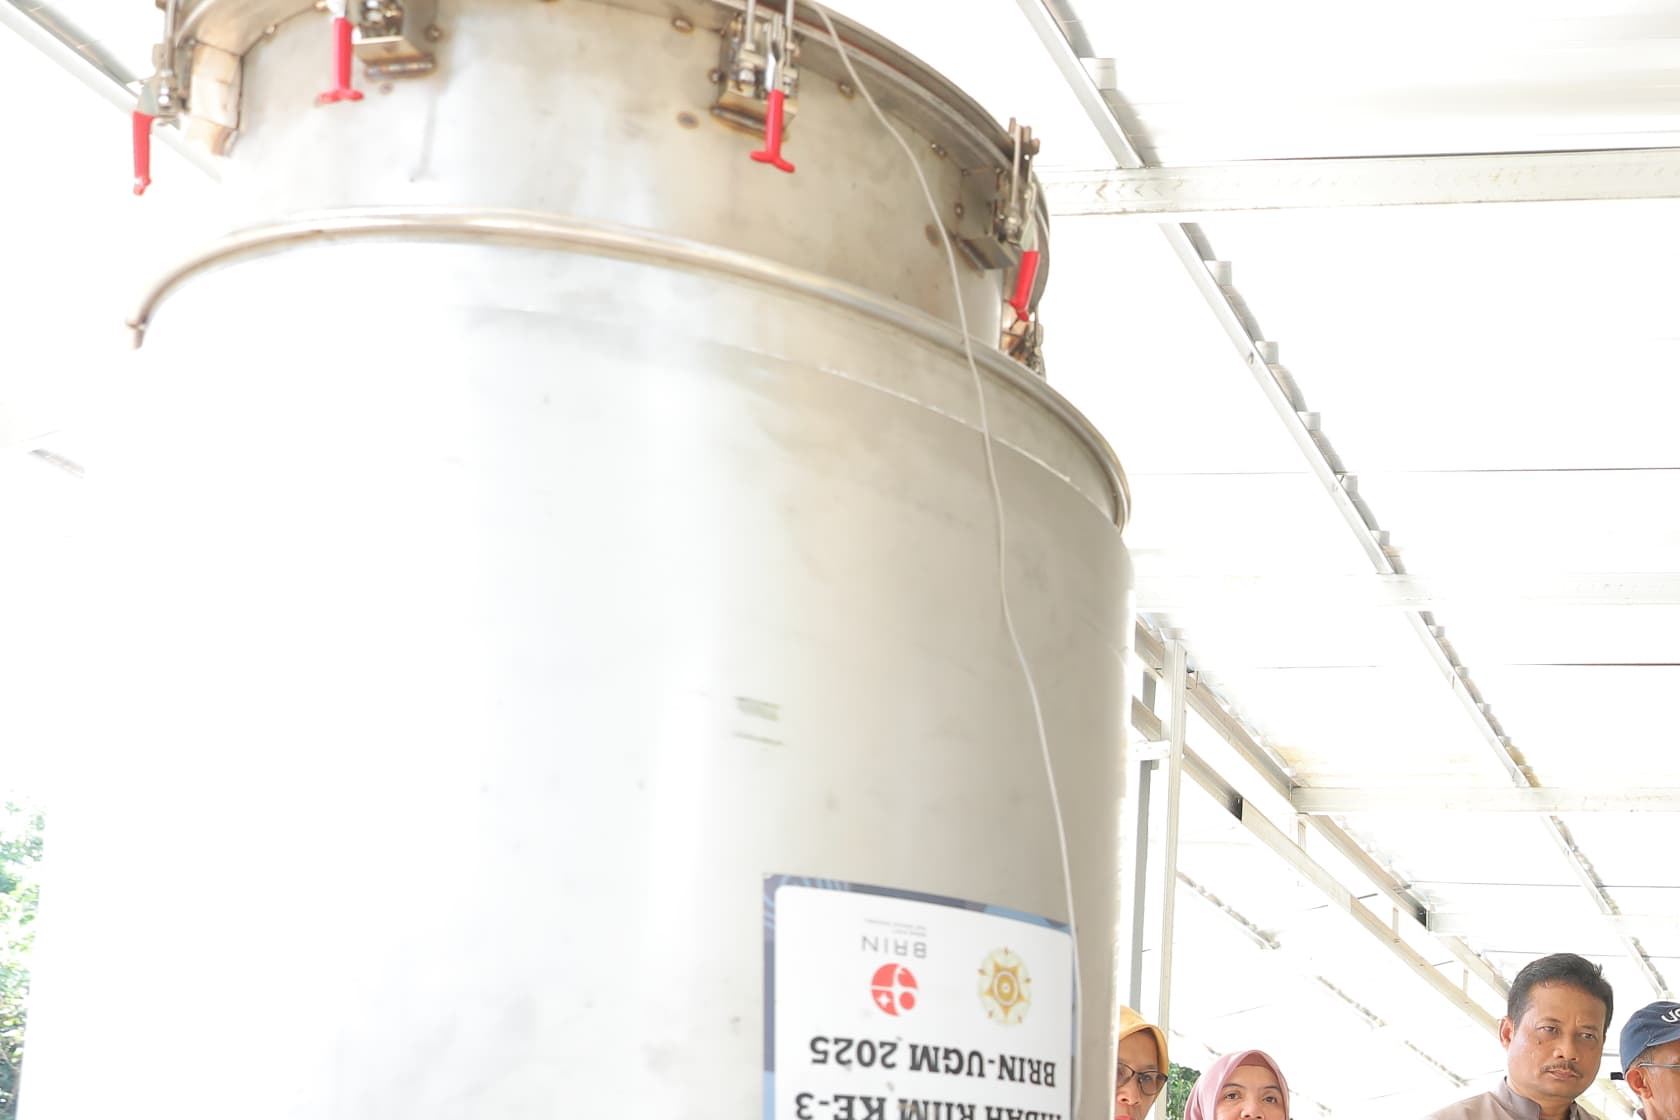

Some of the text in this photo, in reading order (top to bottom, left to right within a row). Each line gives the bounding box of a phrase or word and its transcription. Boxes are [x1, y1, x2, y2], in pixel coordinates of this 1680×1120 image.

[861, 935, 928, 959] BRIN
[809, 1036, 1056, 1087] BRIN-UGM 2025
